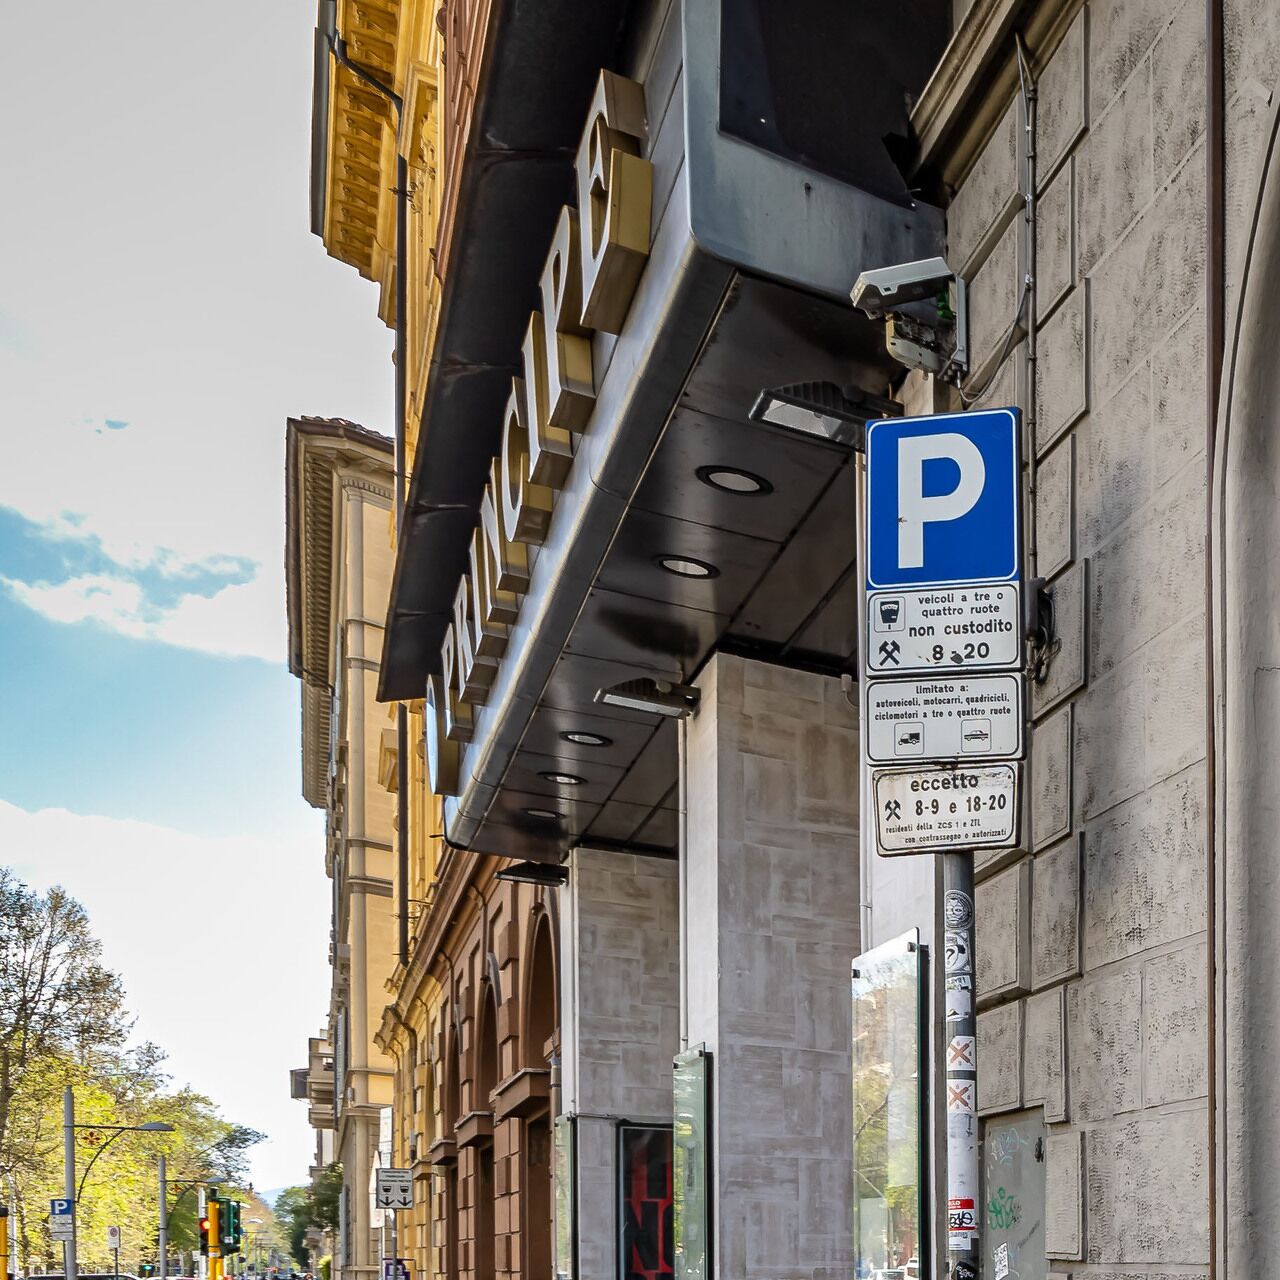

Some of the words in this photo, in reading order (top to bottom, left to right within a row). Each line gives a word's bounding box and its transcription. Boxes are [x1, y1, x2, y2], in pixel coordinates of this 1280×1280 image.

[898, 432, 986, 569] P
[918, 593, 954, 605] veicoli
[961, 594, 967, 602] a
[974, 592, 990, 601] tre
[997, 592, 1003, 600] o
[922, 606, 964, 618] quattro
[970, 604, 1000, 614] ruote
[909, 625, 935, 637] non
[944, 619, 1013, 635] custodito
[932, 644, 944, 661] 8
[963, 642, 990, 660] 20
[916, 685, 954, 694] limitato
[932, 710, 944, 718] tre
[956, 707, 986, 718] quattro
[989, 706, 1011, 715] ruote
[910, 773, 979, 792] eccetto
[915, 799, 939, 816] 8-9
[949, 802, 957, 814] e
[966, 793, 1007, 813] 18-20
[55, 1201, 67, 1214] P
